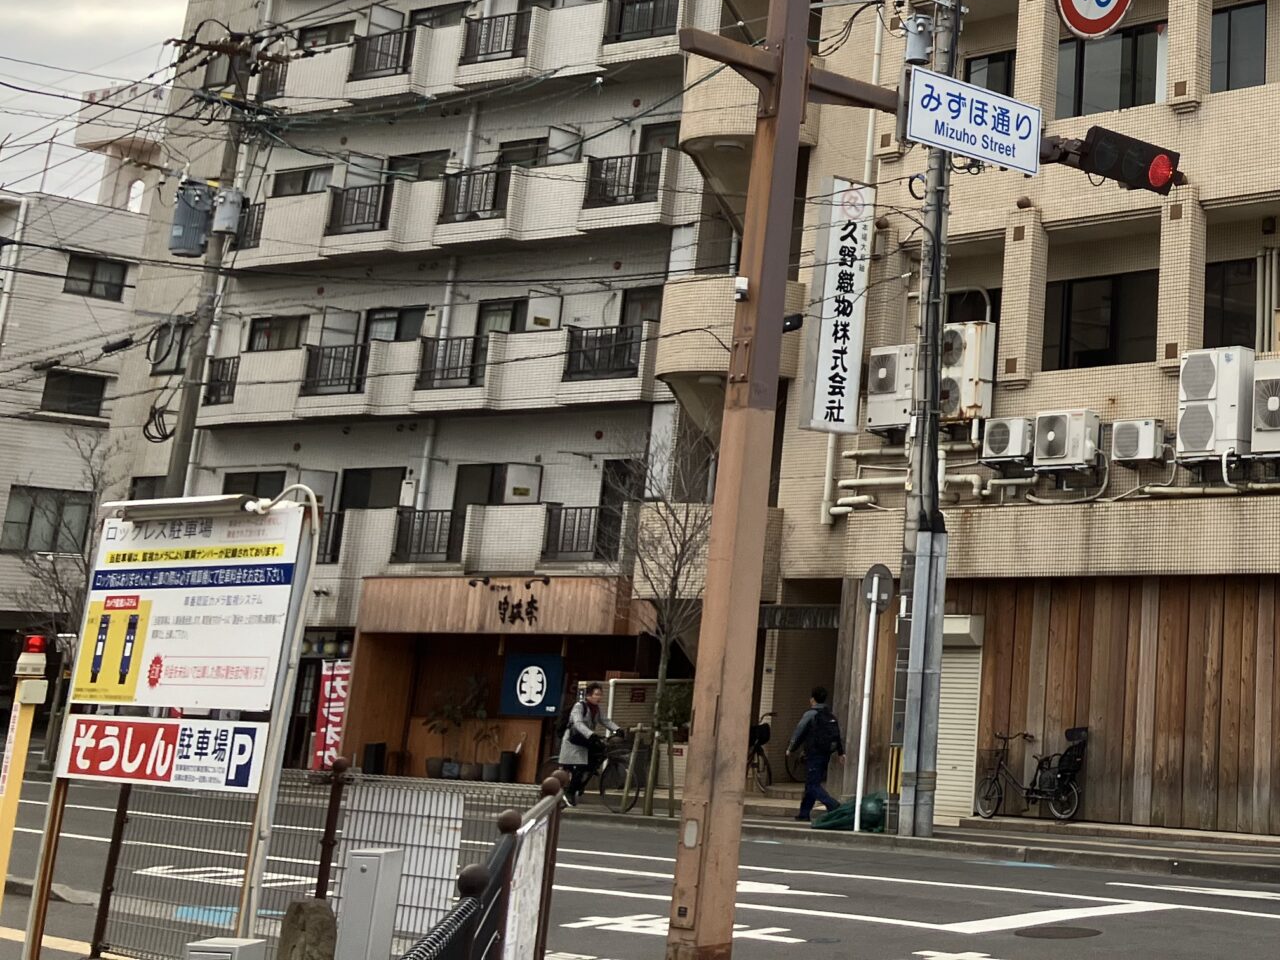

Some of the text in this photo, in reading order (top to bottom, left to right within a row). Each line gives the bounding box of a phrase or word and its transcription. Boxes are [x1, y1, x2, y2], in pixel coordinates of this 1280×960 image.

[920, 83, 1032, 140] みずほ通り
[934, 119, 1016, 158] Mizuho Street
[824, 219, 858, 423] 久野織物株式会社
[106, 520, 214, 541] ロックレス駐車場
[73, 723, 175, 778] そうしん
[176, 726, 229, 762] 駐車場
[227, 733, 253, 780] P
